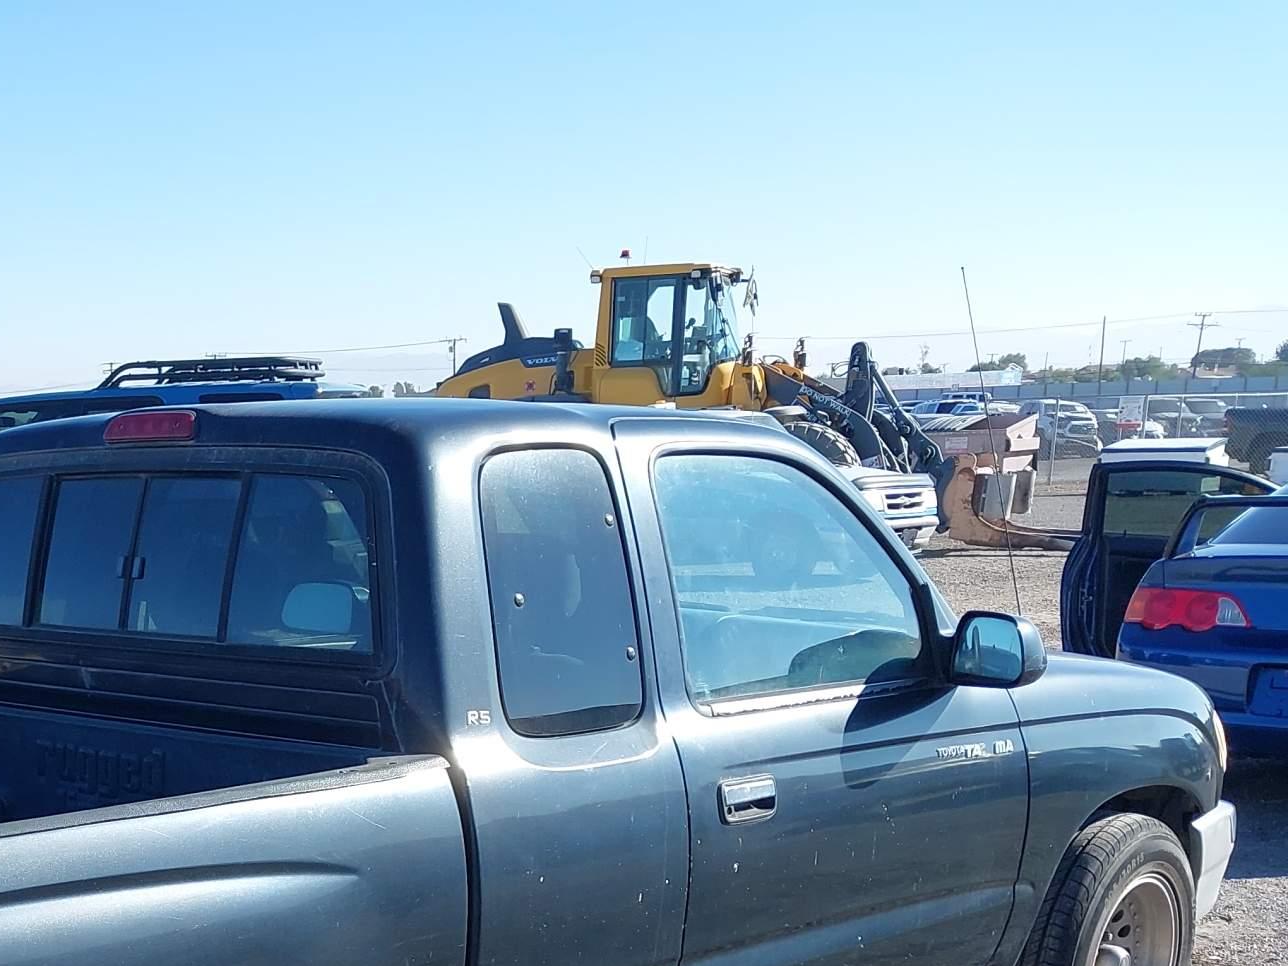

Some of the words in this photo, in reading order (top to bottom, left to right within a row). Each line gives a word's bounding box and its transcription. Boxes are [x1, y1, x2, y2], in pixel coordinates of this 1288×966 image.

[525, 355, 558, 365] VOLV
[814, 390, 828, 405] NOT
[936, 745, 964, 758] TOYOTA
[965, 739, 1014, 758] TAMA
